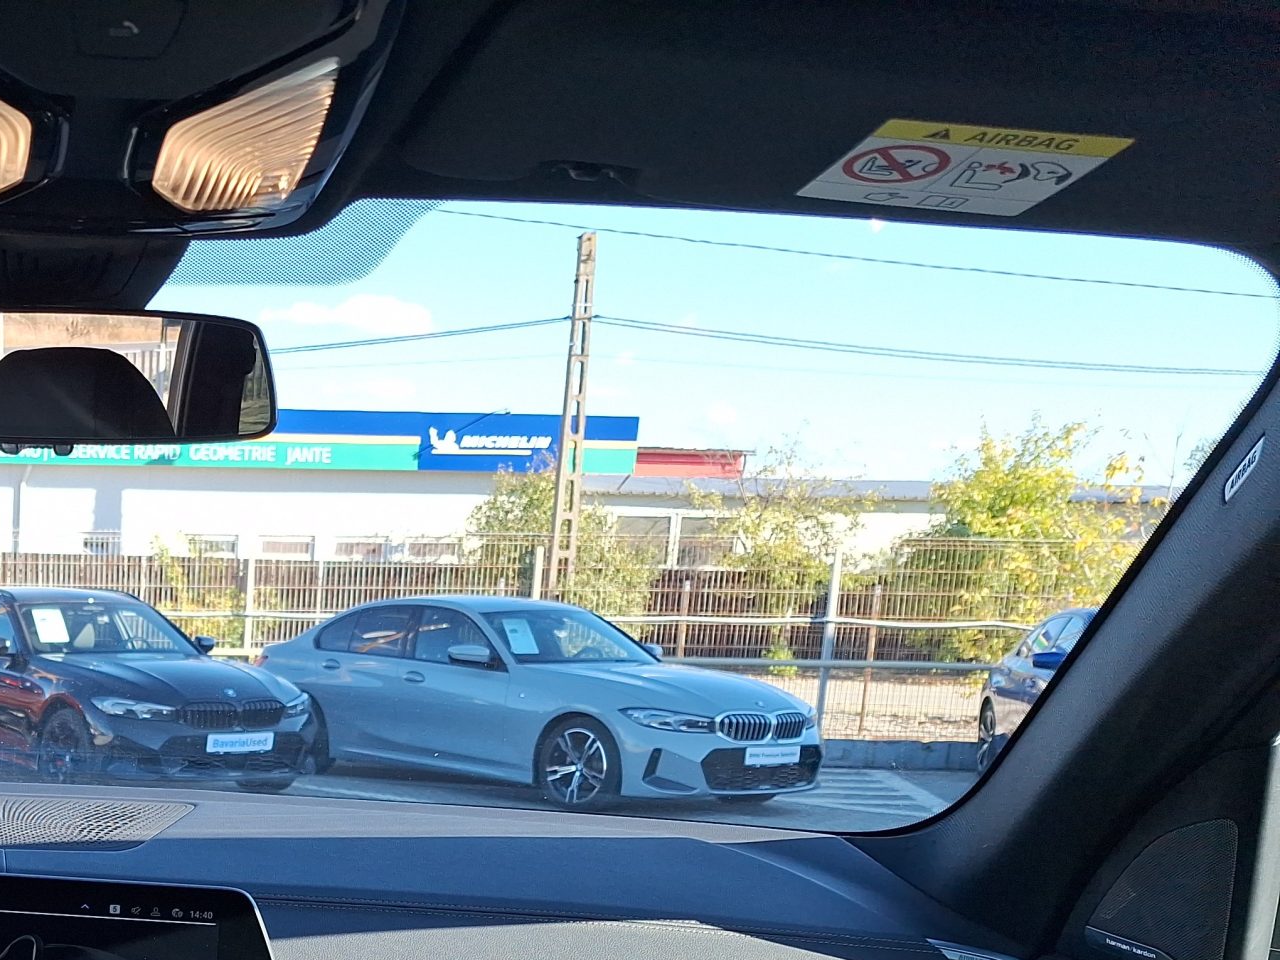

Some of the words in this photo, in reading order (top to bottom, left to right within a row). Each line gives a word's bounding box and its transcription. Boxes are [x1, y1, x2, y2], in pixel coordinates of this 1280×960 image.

[964, 130, 1079, 151] AIRBAG
[460, 434, 552, 450] MICHELIN
[133, 444, 181, 460] RAPID
[189, 446, 276, 463] GEOMETRIE
[285, 447, 332, 465] JANTE
[212, 737, 269, 749] BavariaUsed
[189, 910, 214, 920] 14:40
[1106, 938, 1157, 959] harman/kardon
